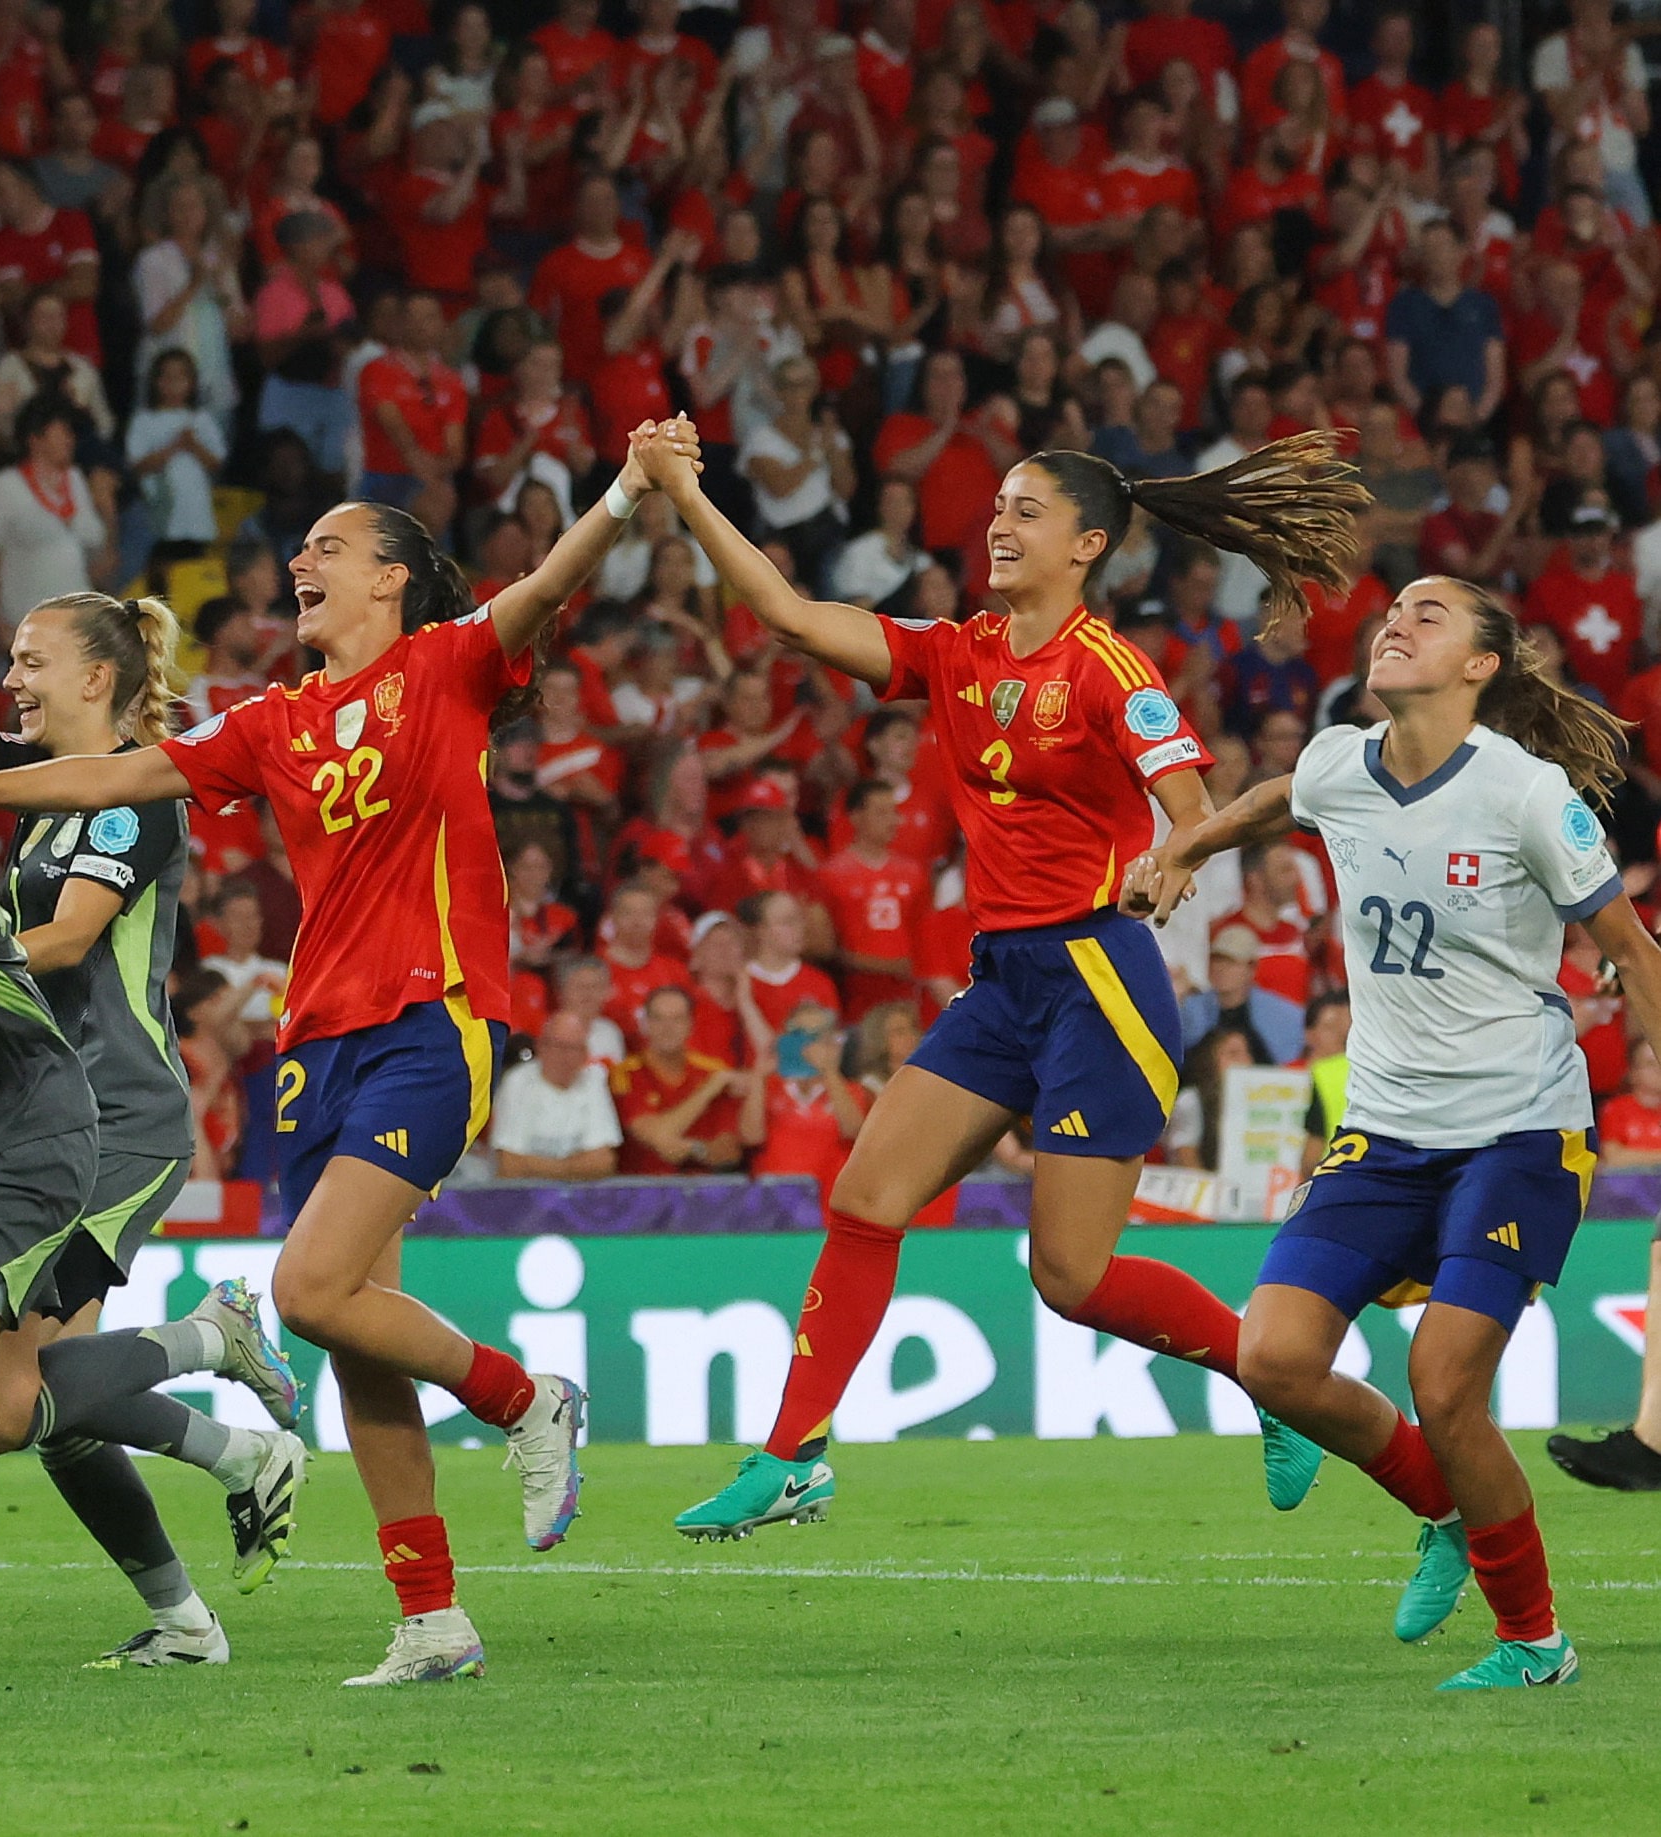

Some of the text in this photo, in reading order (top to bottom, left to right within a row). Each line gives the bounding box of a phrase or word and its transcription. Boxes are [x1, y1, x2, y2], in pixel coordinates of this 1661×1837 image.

[311, 746, 391, 835] 22
[979, 738, 1018, 806] 3
[1359, 894, 1445, 980] 22
